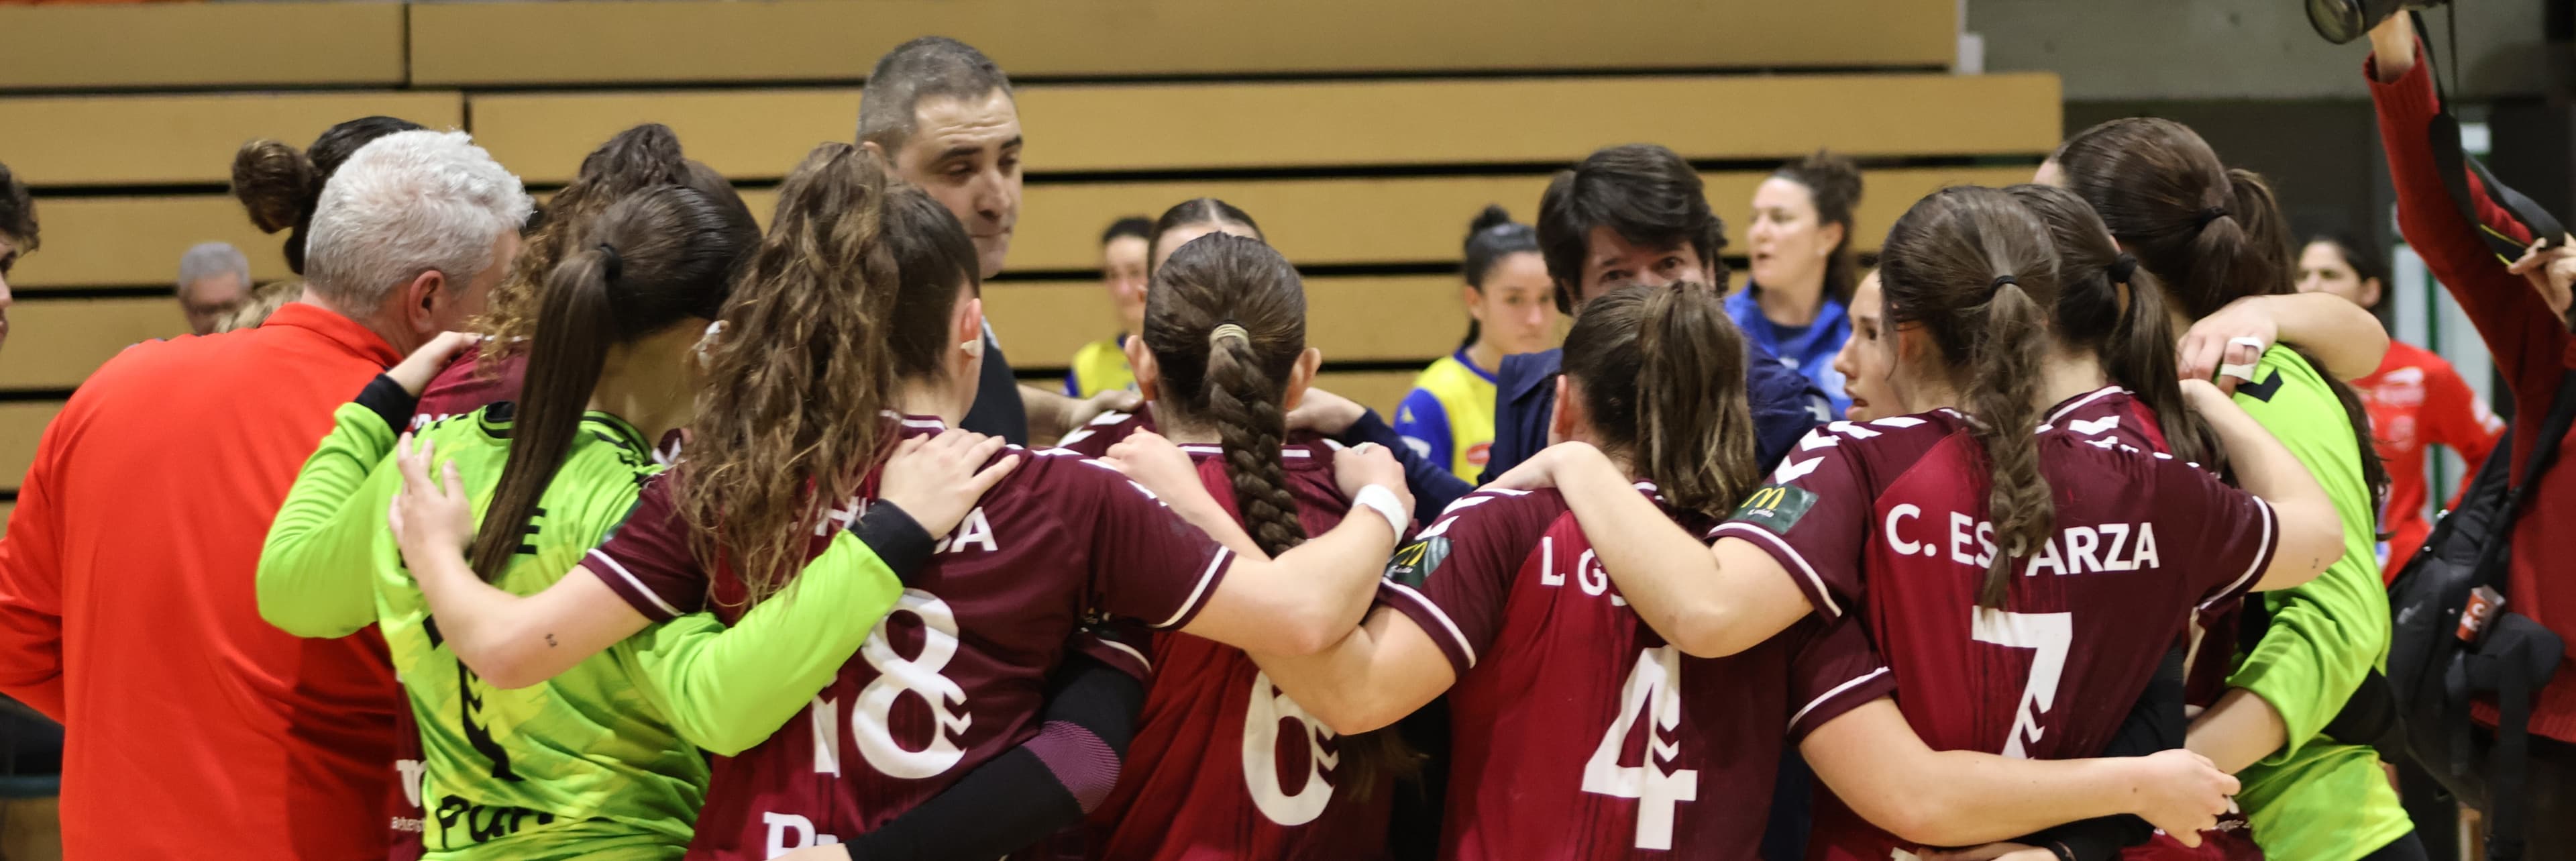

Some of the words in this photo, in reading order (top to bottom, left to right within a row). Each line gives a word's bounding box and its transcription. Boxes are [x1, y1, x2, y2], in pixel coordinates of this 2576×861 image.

[1886, 503, 1937, 556] C.
[812, 587, 973, 779] 18
[1242, 669, 1340, 826] 6
[1581, 644, 1699, 851] 4
[1972, 605, 2074, 760] 7
